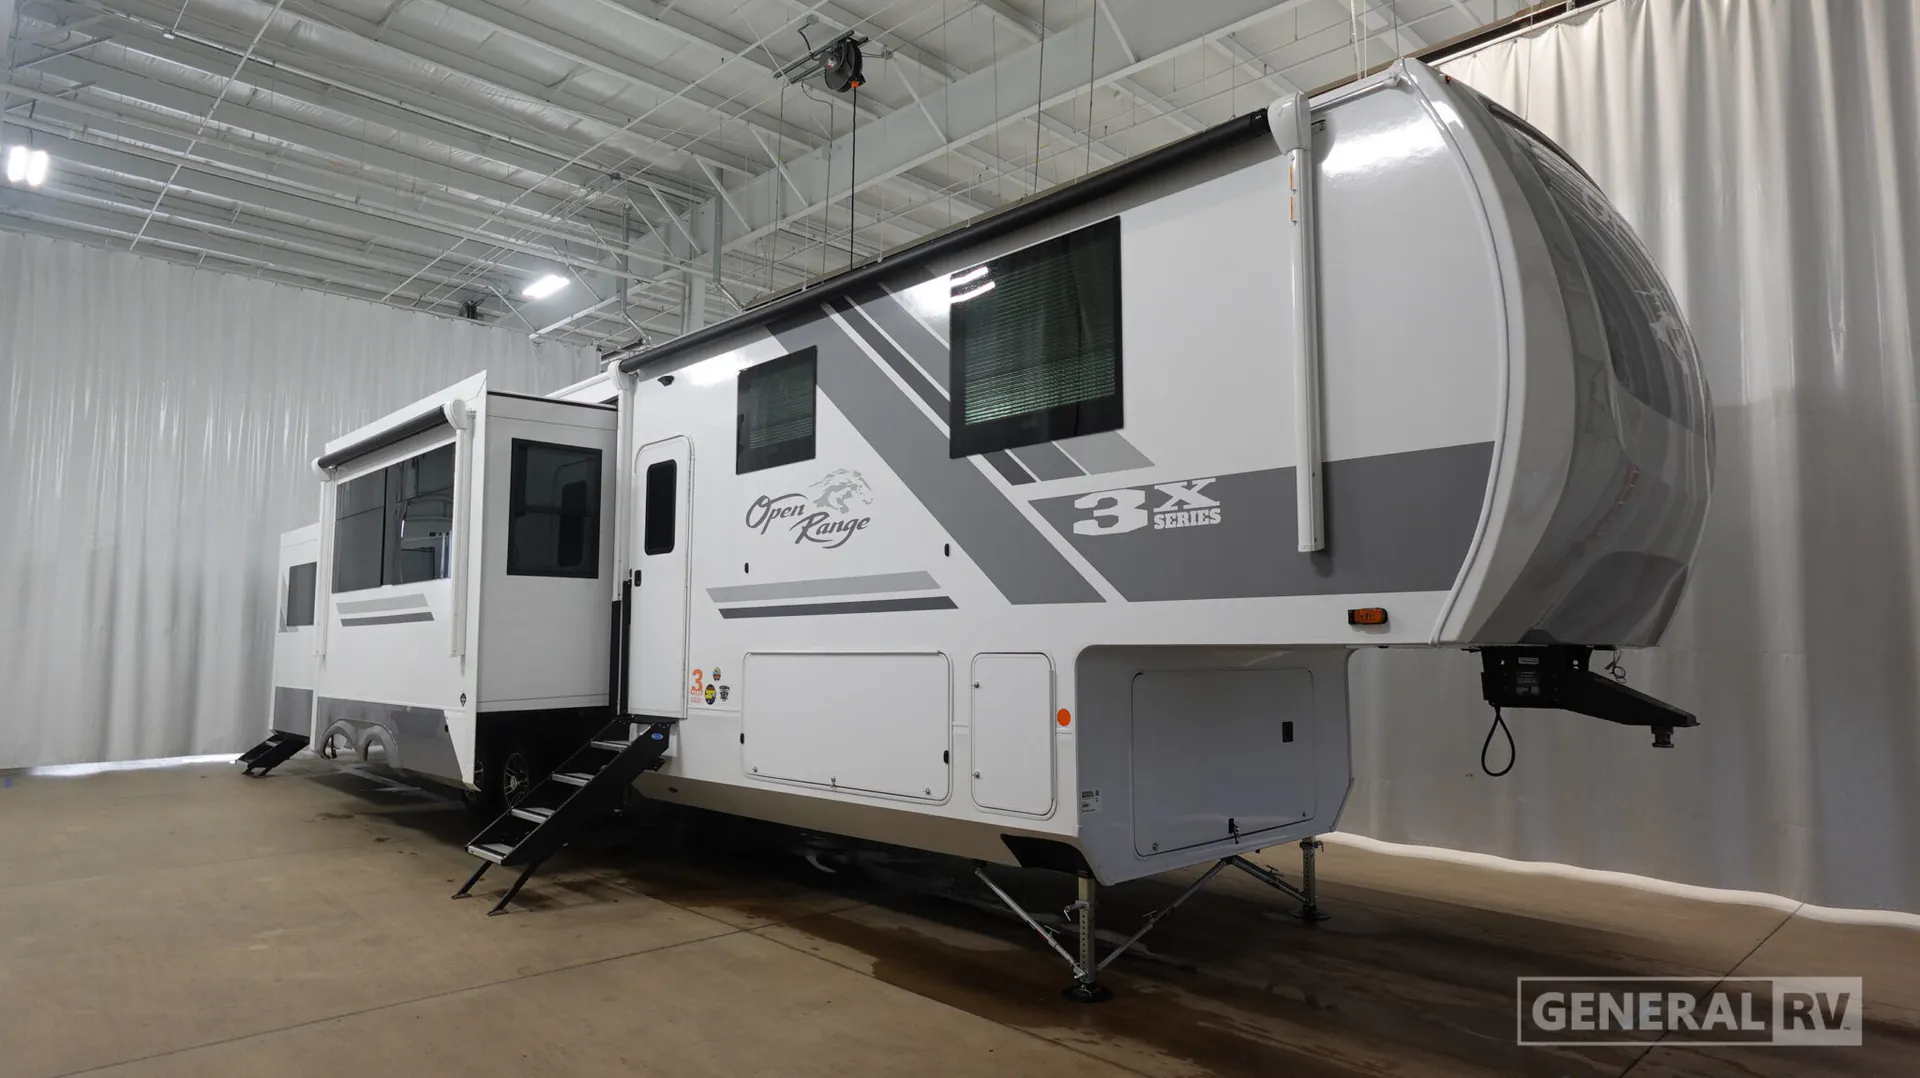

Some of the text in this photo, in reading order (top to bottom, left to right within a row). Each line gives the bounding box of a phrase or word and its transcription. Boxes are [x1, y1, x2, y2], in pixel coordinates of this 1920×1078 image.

[745, 493, 808, 535] Open
[1073, 478, 1220, 536] 3 X
[1153, 508, 1222, 530] SERIES
[789, 511, 871, 549] Range
[691, 668, 703, 691] 3
